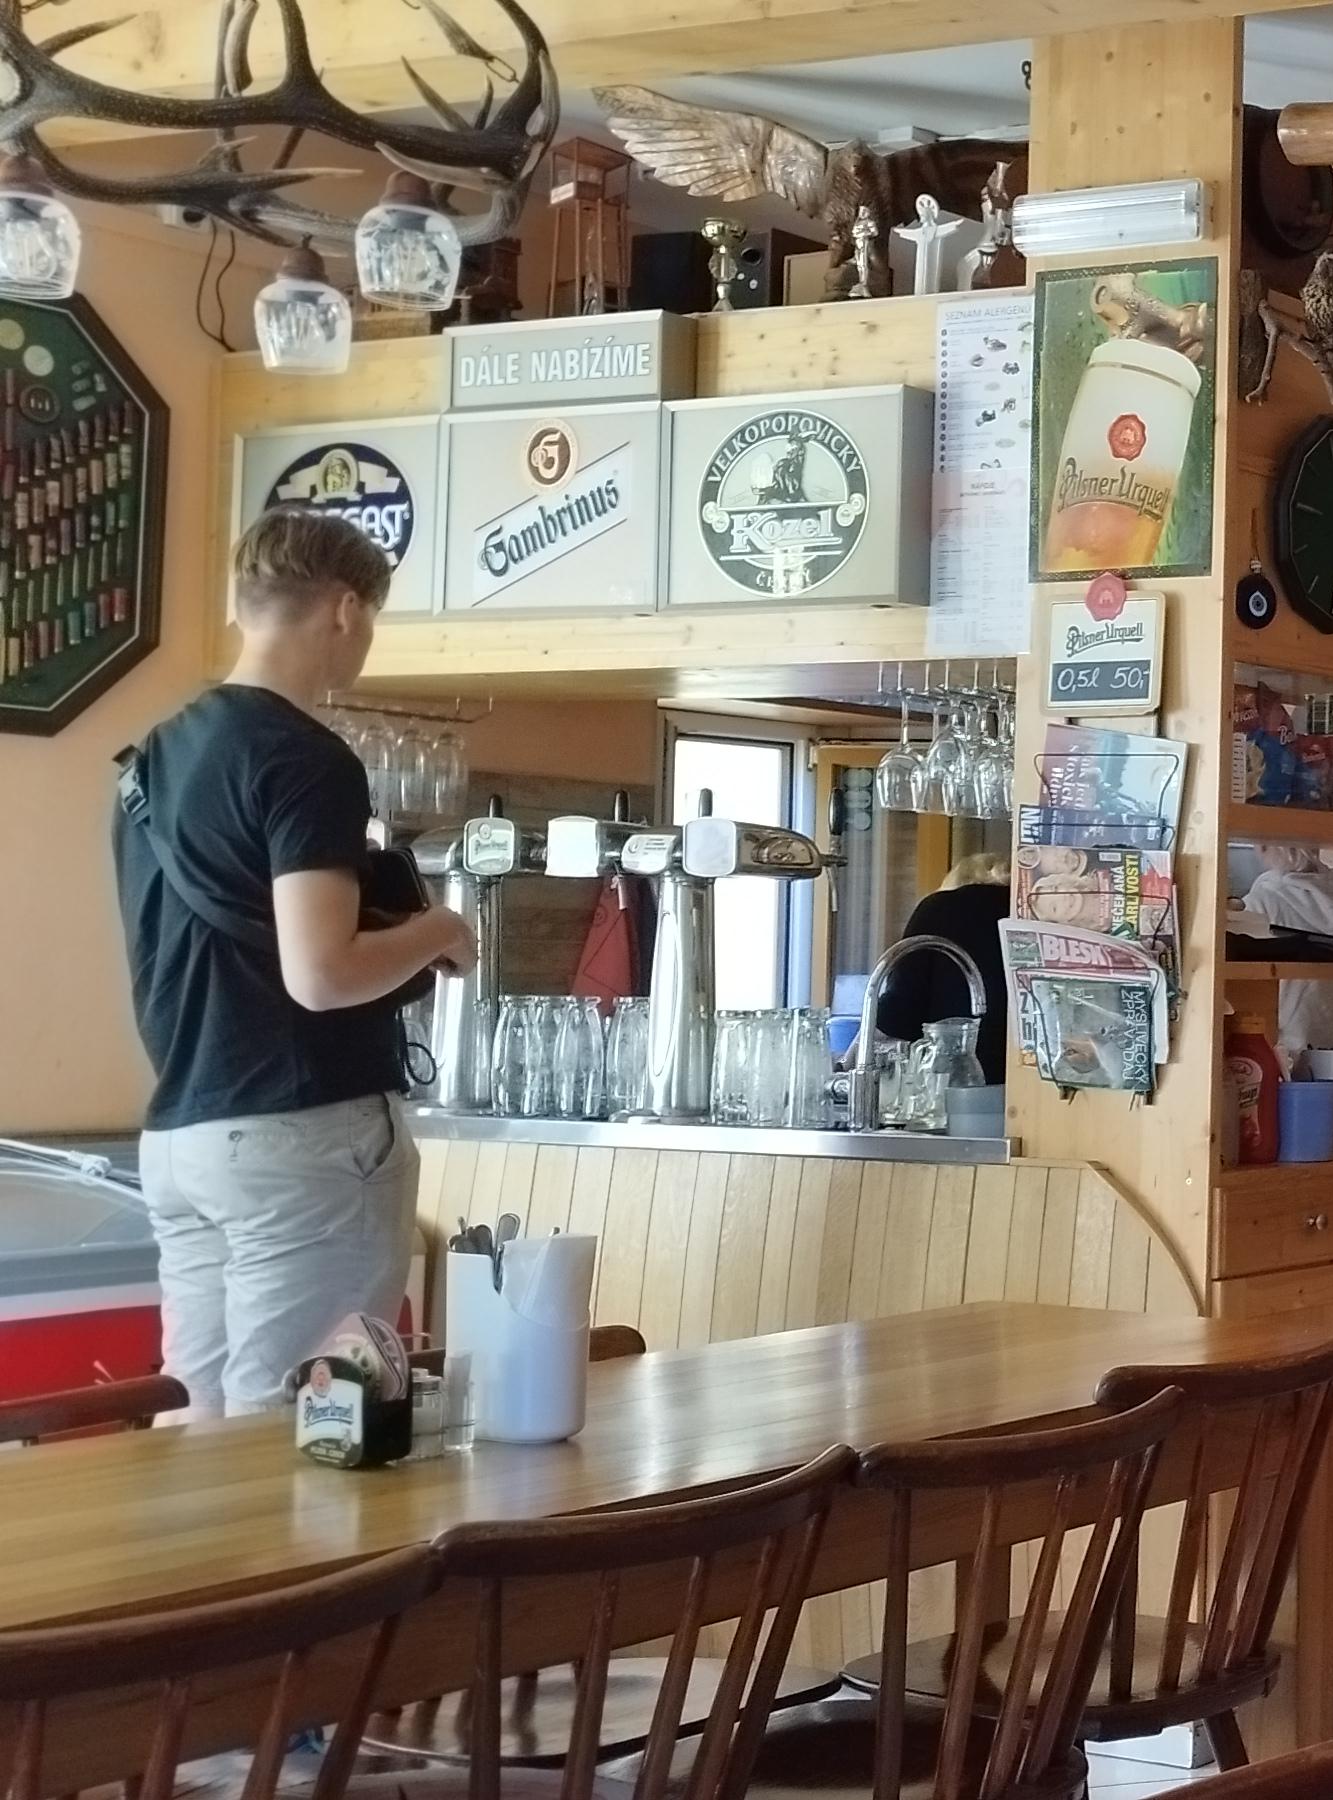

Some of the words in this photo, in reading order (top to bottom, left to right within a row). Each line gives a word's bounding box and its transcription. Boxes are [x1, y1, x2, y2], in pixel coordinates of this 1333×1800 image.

[460, 344, 520, 387] DÁLE
[530, 335, 650, 383] NABÍZÍME
[1056, 456, 1121, 514] Pilsner
[1118, 465, 1170, 518] Urquell
[478, 479, 620, 578] Gambrinus
[728, 508, 843, 555] Kozel
[1065, 625, 1105, 658] Pilsner
[1104, 622, 1144, 645] Urquell
[1125, 854, 1140, 931] ARLIVOSTI
